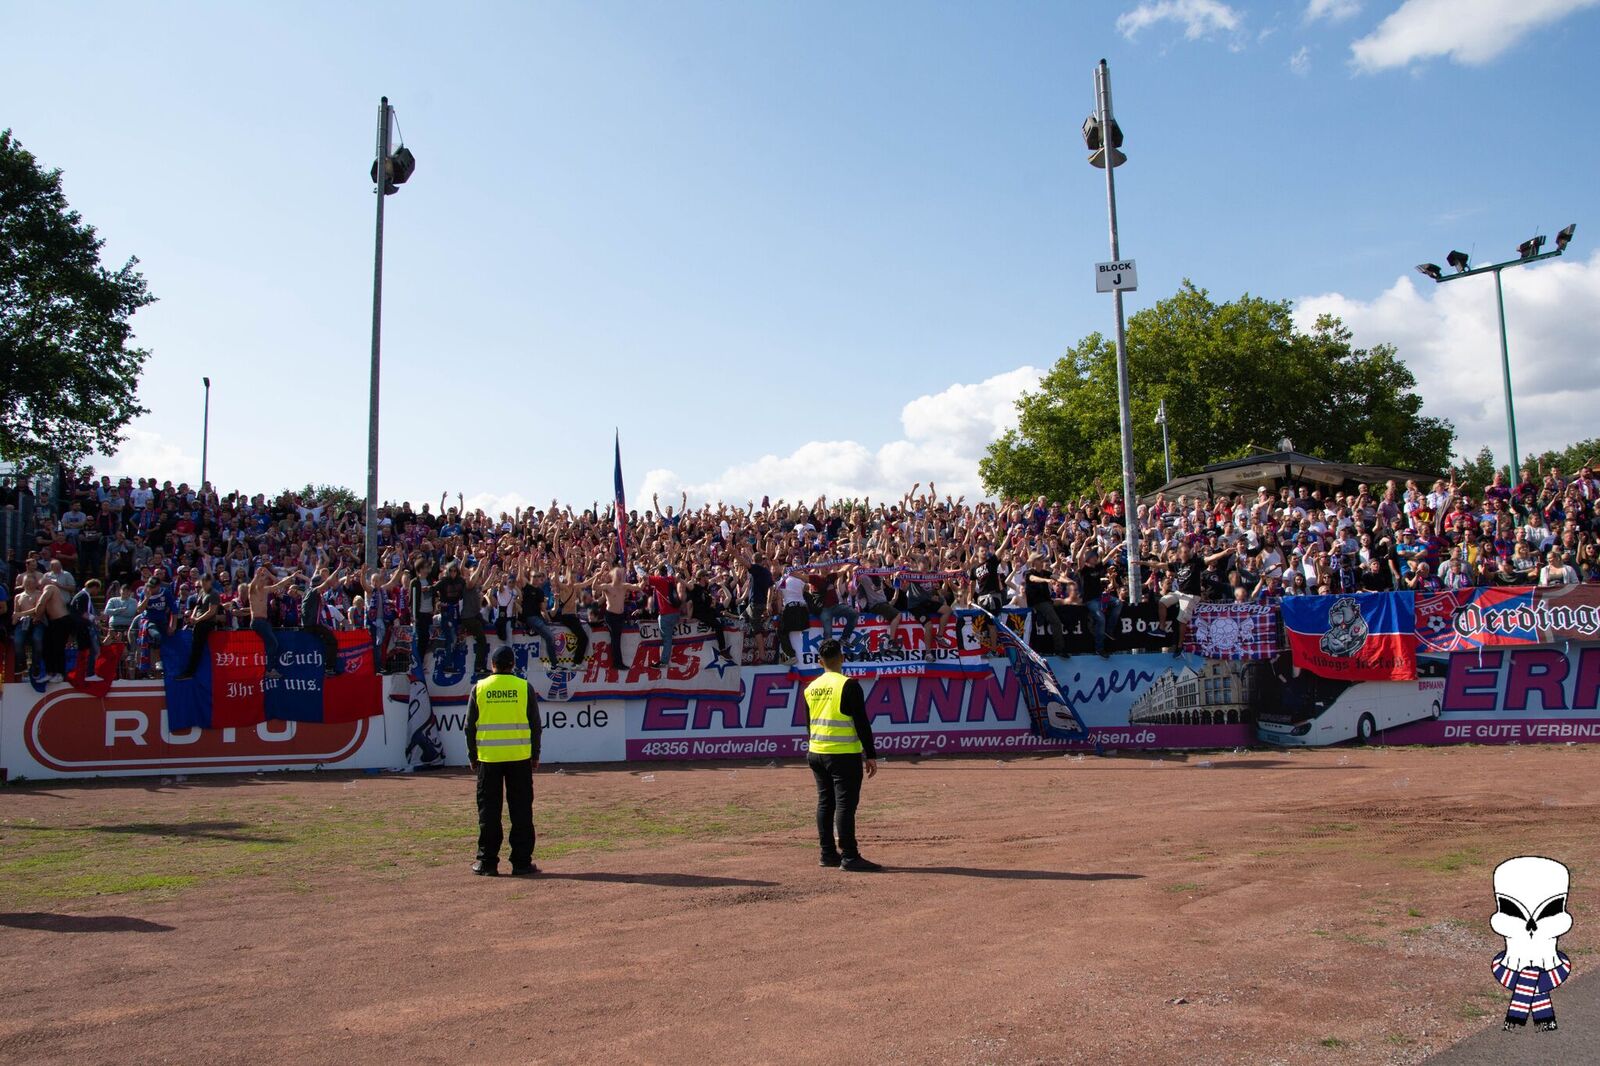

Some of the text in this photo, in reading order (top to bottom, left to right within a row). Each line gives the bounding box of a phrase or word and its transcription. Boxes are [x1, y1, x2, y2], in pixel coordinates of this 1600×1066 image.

[1099, 263, 1132, 272] BLOCK
[1113, 273, 1122, 285] J
[1420, 602, 1444, 616] KFC
[832, 614, 866, 627] LOE
[802, 630, 864, 654] KC
[877, 664, 926, 676] RACISM
[226, 682, 254, 698] Ihr
[285, 676, 321, 692] uns.
[486, 689, 518, 699] ORDNER
[1444, 725, 1472, 738] DIE
[1476, 724, 1522, 737] GUTE
[641, 740, 689, 756] 48356
[692, 738, 778, 754] Nordwalde
